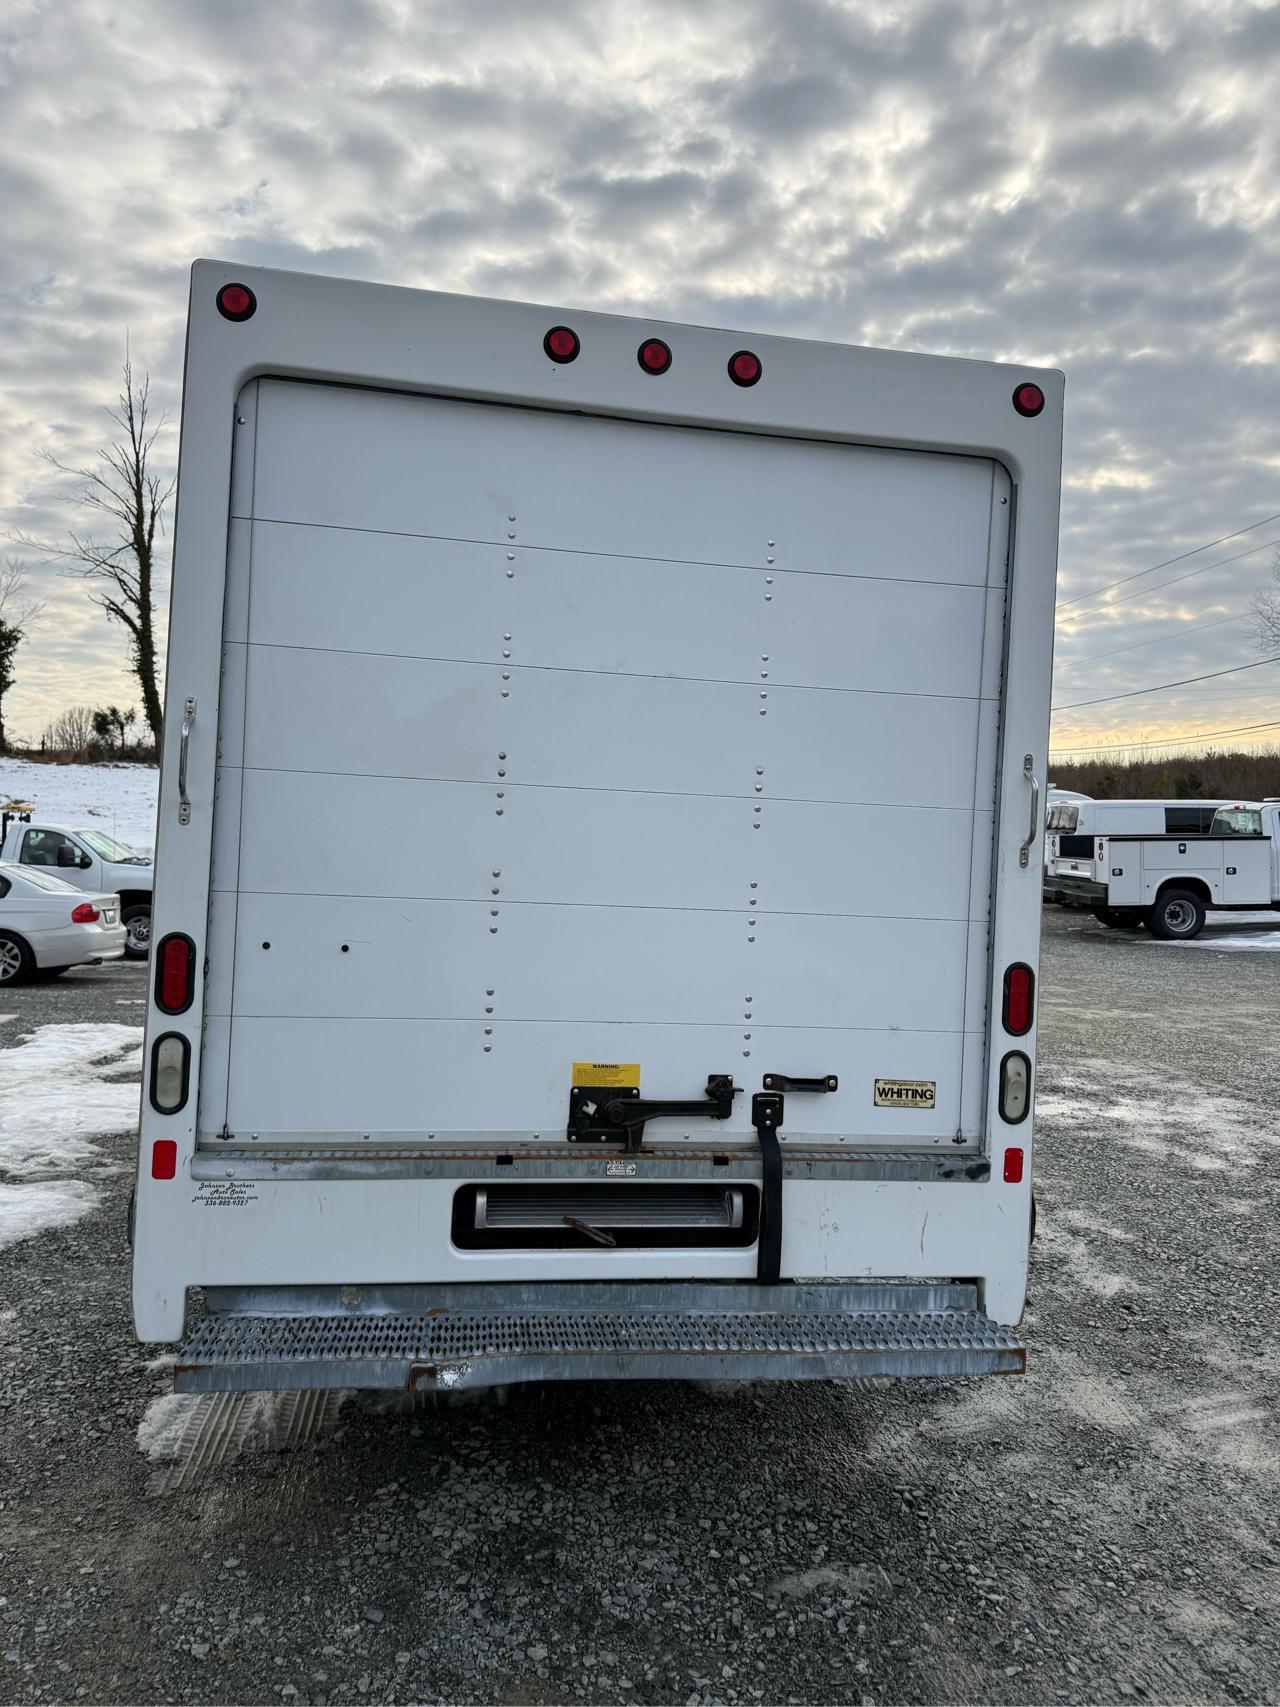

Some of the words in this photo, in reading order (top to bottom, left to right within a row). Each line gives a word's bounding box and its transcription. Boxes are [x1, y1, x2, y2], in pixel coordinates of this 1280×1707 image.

[877, 1087, 933, 1100] WHITING
[198, 1182, 225, 1191] Johnson
[226, 1182, 255, 1190] Brothers
